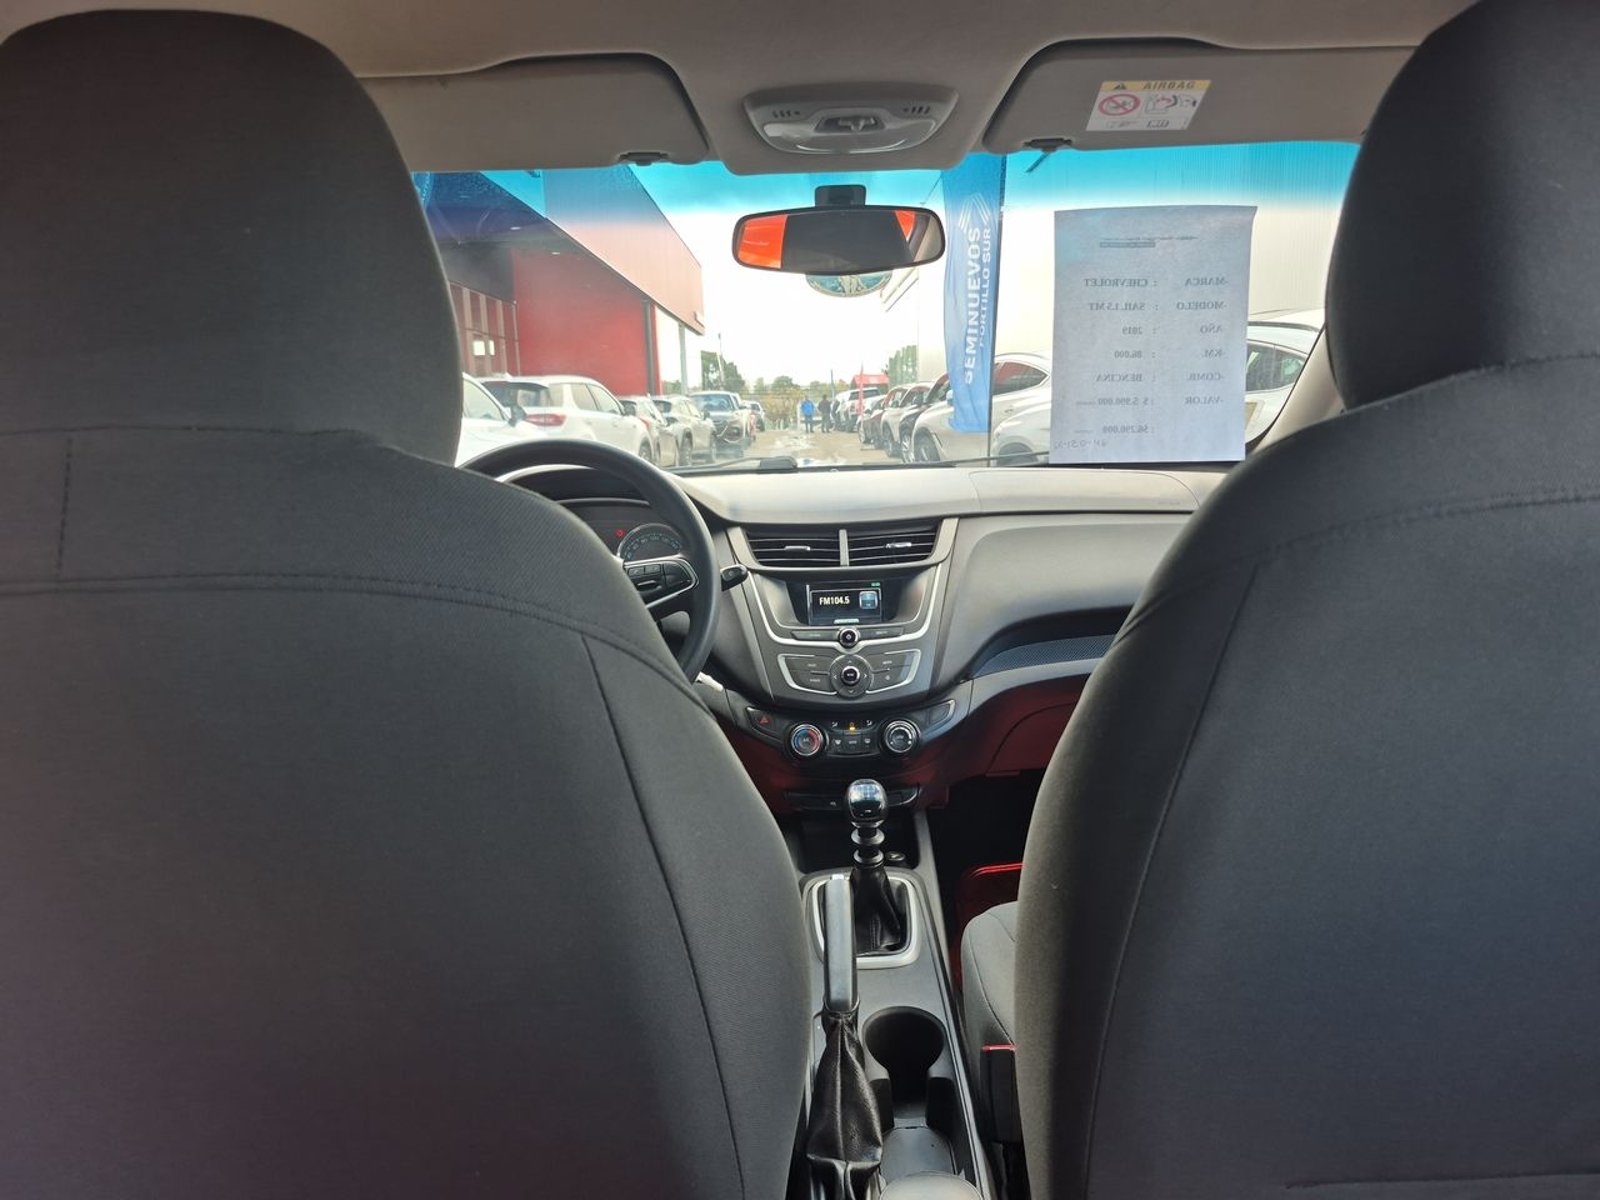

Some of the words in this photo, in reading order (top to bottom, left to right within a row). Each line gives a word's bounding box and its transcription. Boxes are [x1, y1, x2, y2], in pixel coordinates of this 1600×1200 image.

[981, 227, 991, 264] SUR
[963, 227, 981, 385] SEMINUEVOS
[978, 267, 991, 348] PORTILLO
[819, 595, 850, 606] FM104.5
